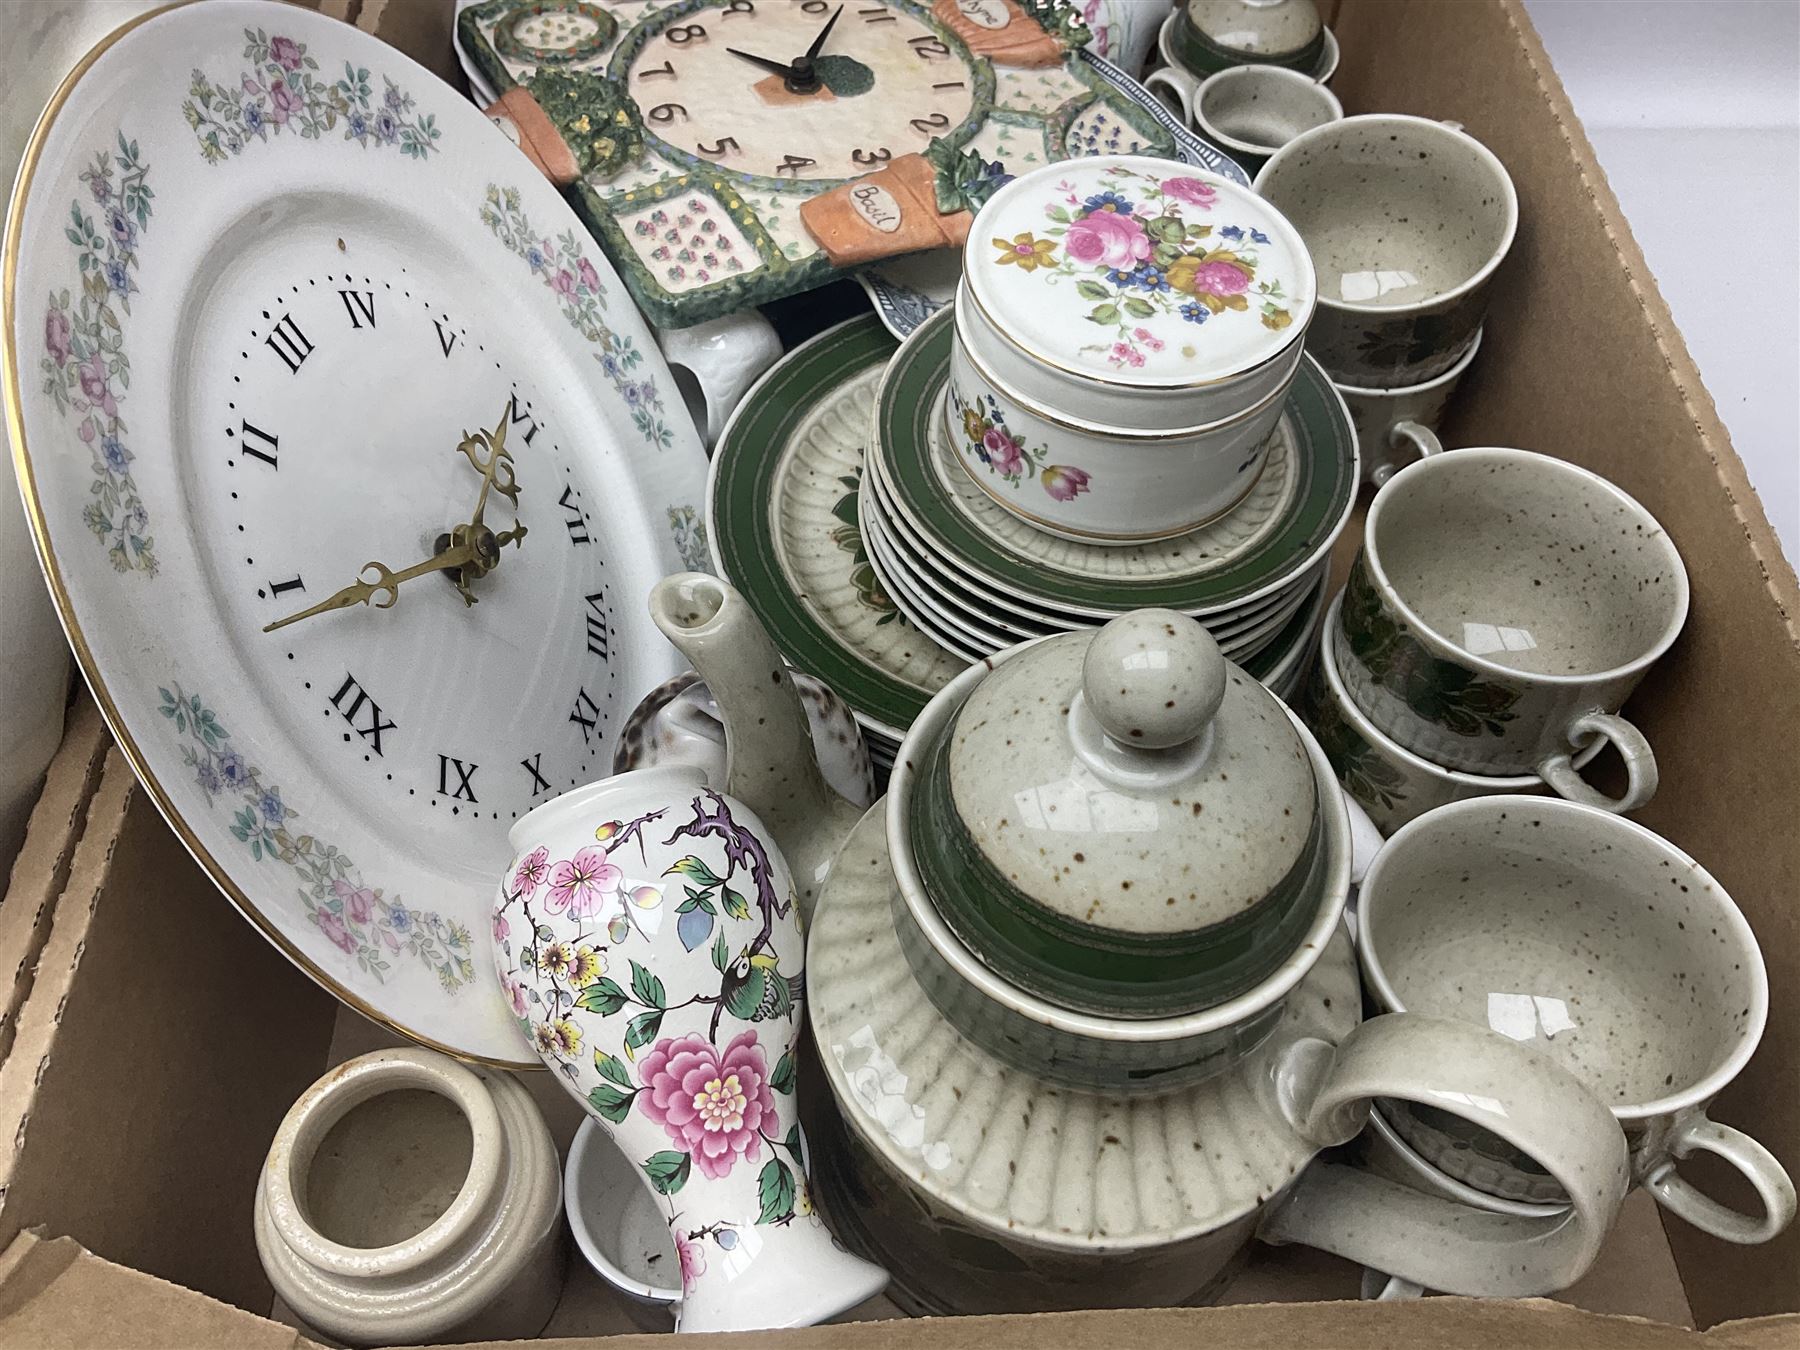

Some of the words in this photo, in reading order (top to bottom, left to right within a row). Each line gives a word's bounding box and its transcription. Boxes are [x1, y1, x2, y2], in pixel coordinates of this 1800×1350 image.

[858, 8, 897, 23] 11
[960, 0, 998, 25] hyme
[665, 25, 706, 43] 8
[907, 35, 950, 59] 12
[639, 61, 675, 77] 7
[649, 103, 688, 121] 6
[910, 113, 949, 133] 2
[697, 137, 741, 155] 5
[852, 147, 892, 164] 3
[776, 155, 816, 173] 4
[853, 186, 896, 225] Basil
[337, 290, 376, 329] IV
[264, 312, 316, 375] III
[432, 319, 457, 358] V
[511, 391, 541, 449] VI
[242, 418, 279, 472] II
[558, 482, 592, 547] VII
[268, 573, 306, 599] I
[584, 590, 608, 664] VIII
[328, 671, 398, 758] XII
[520, 753, 552, 797] X
